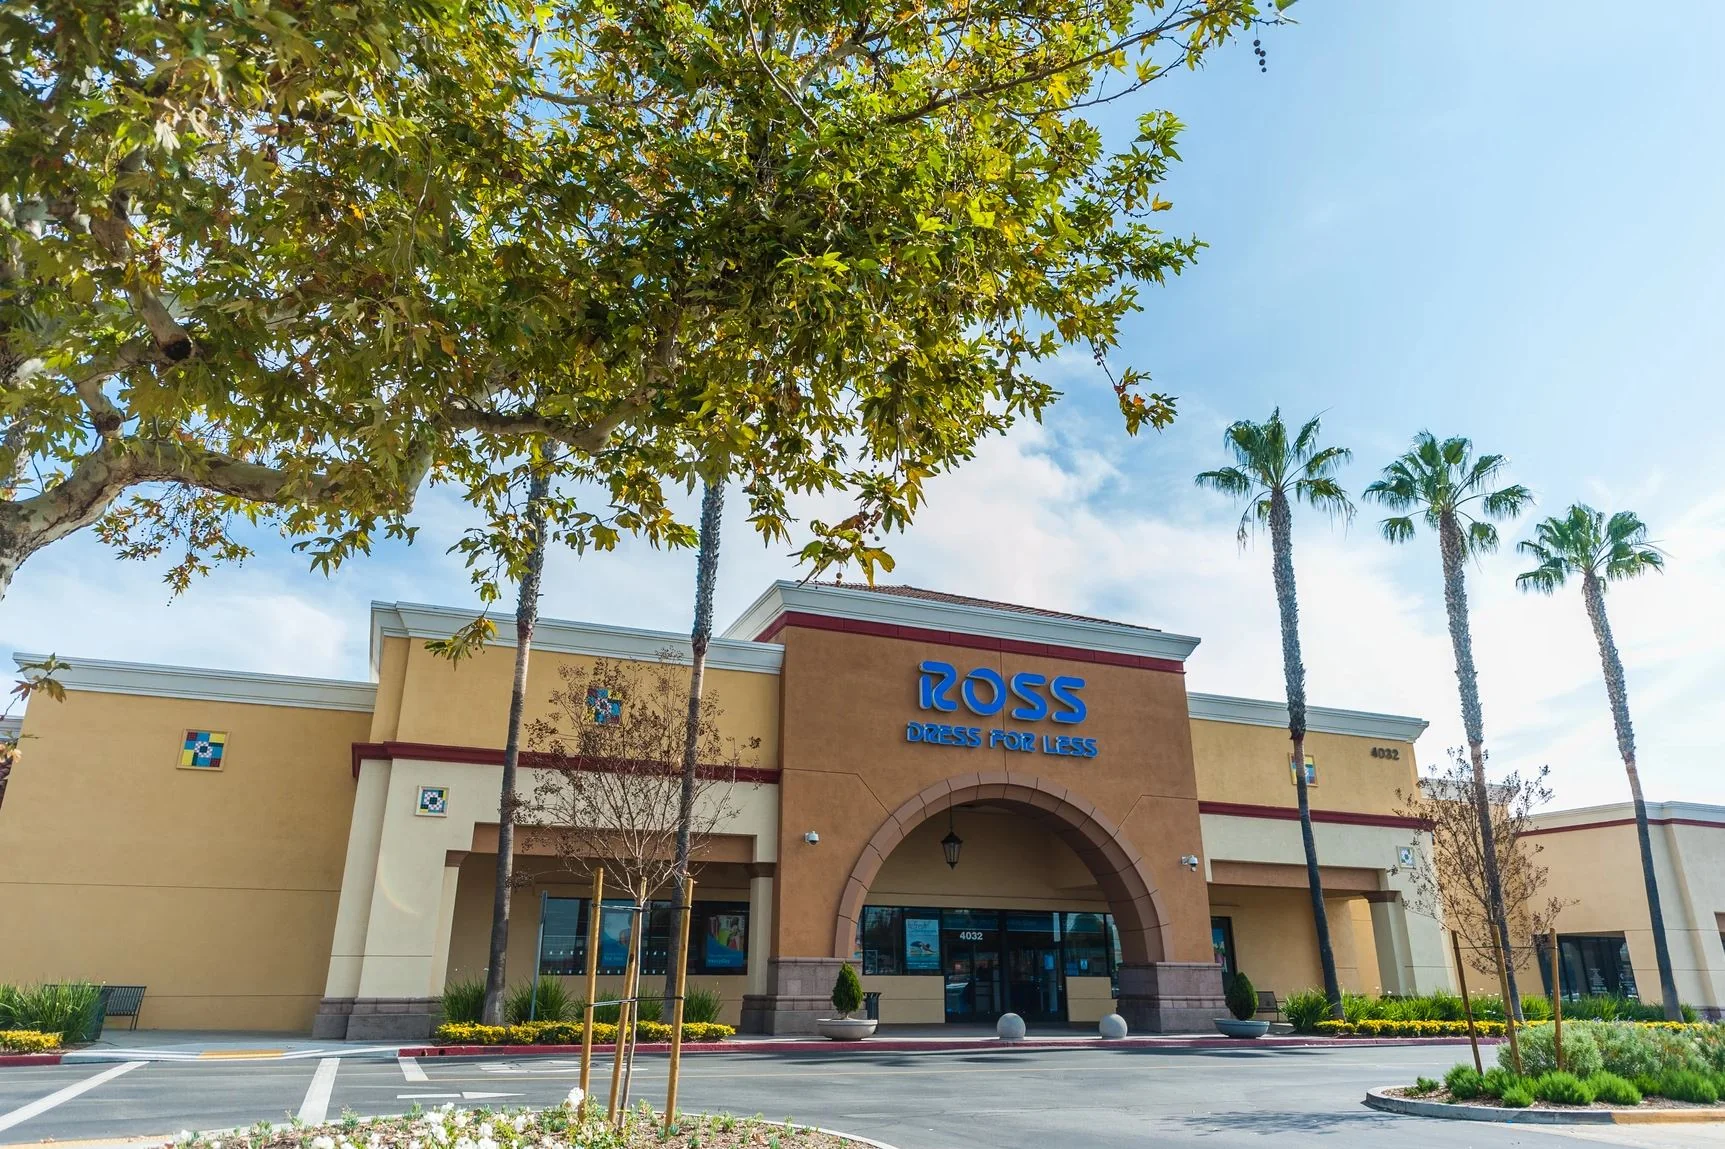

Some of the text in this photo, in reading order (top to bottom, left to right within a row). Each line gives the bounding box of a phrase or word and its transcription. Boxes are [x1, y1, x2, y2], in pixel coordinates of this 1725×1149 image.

[918, 659, 1088, 724] ROSS
[906, 721, 1099, 759] DRESS FOR LESS
[1370, 747, 1400, 761] 4032
[959, 931, 983, 940] 4032
